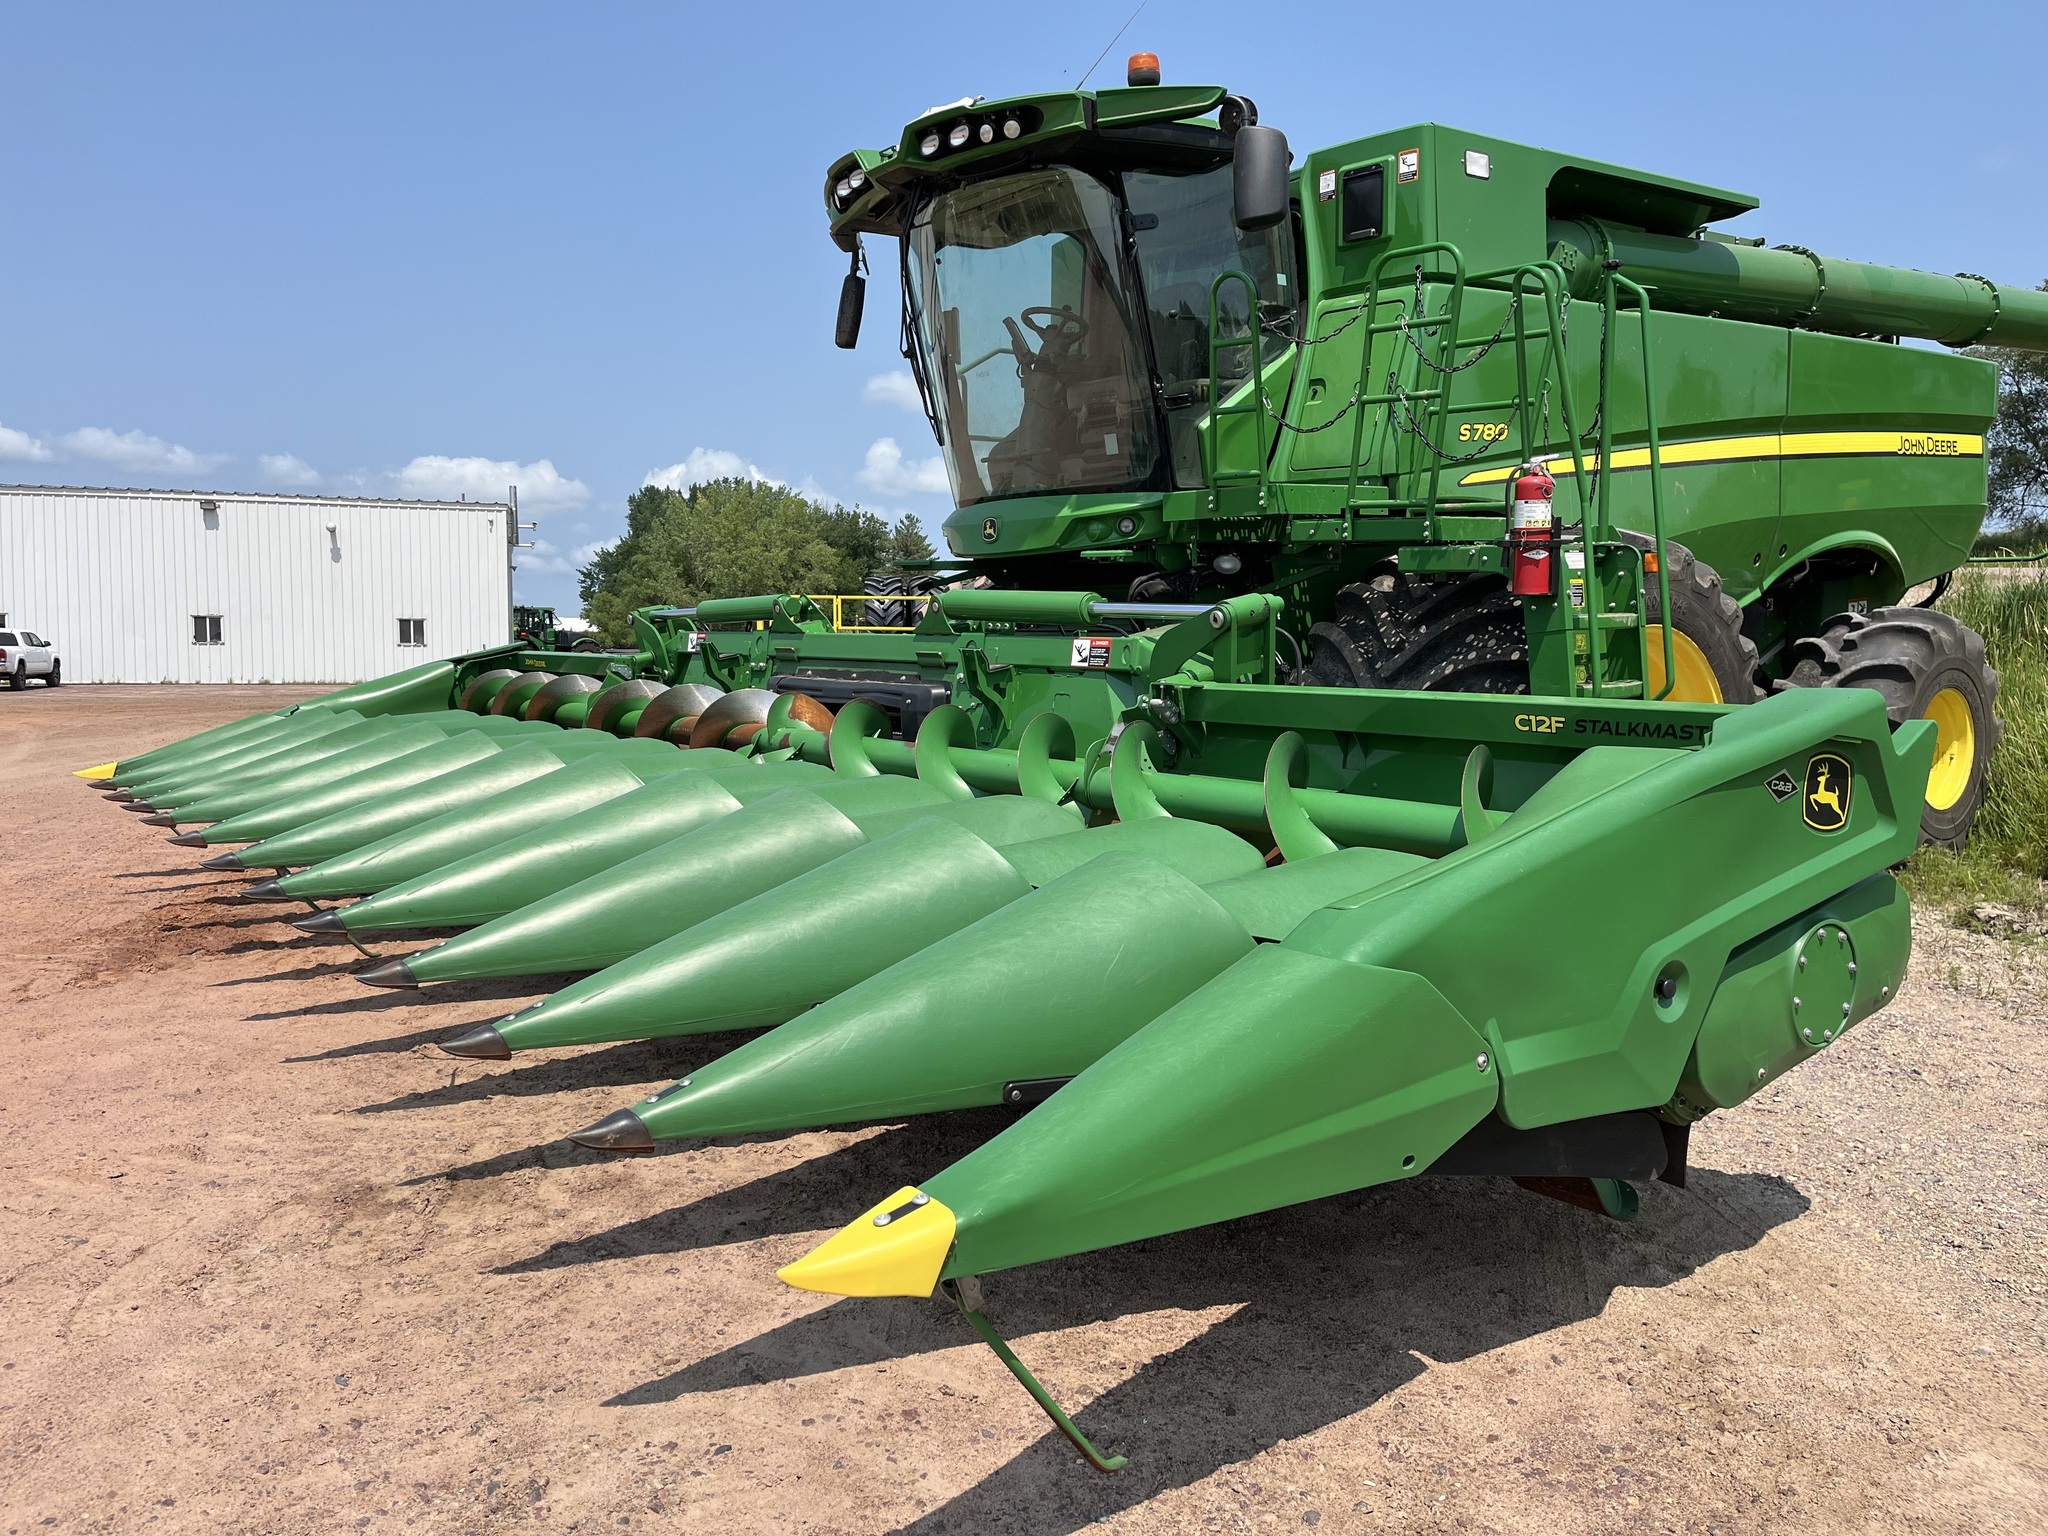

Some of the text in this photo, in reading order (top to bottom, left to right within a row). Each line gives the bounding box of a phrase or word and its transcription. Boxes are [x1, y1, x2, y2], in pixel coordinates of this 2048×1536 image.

[1459, 423, 1509, 442] S780
[1898, 436, 1958, 453] JOHN DEERE
[1514, 714, 1713, 741] C12F STALKMAST
[1771, 780, 1793, 792] C&B
